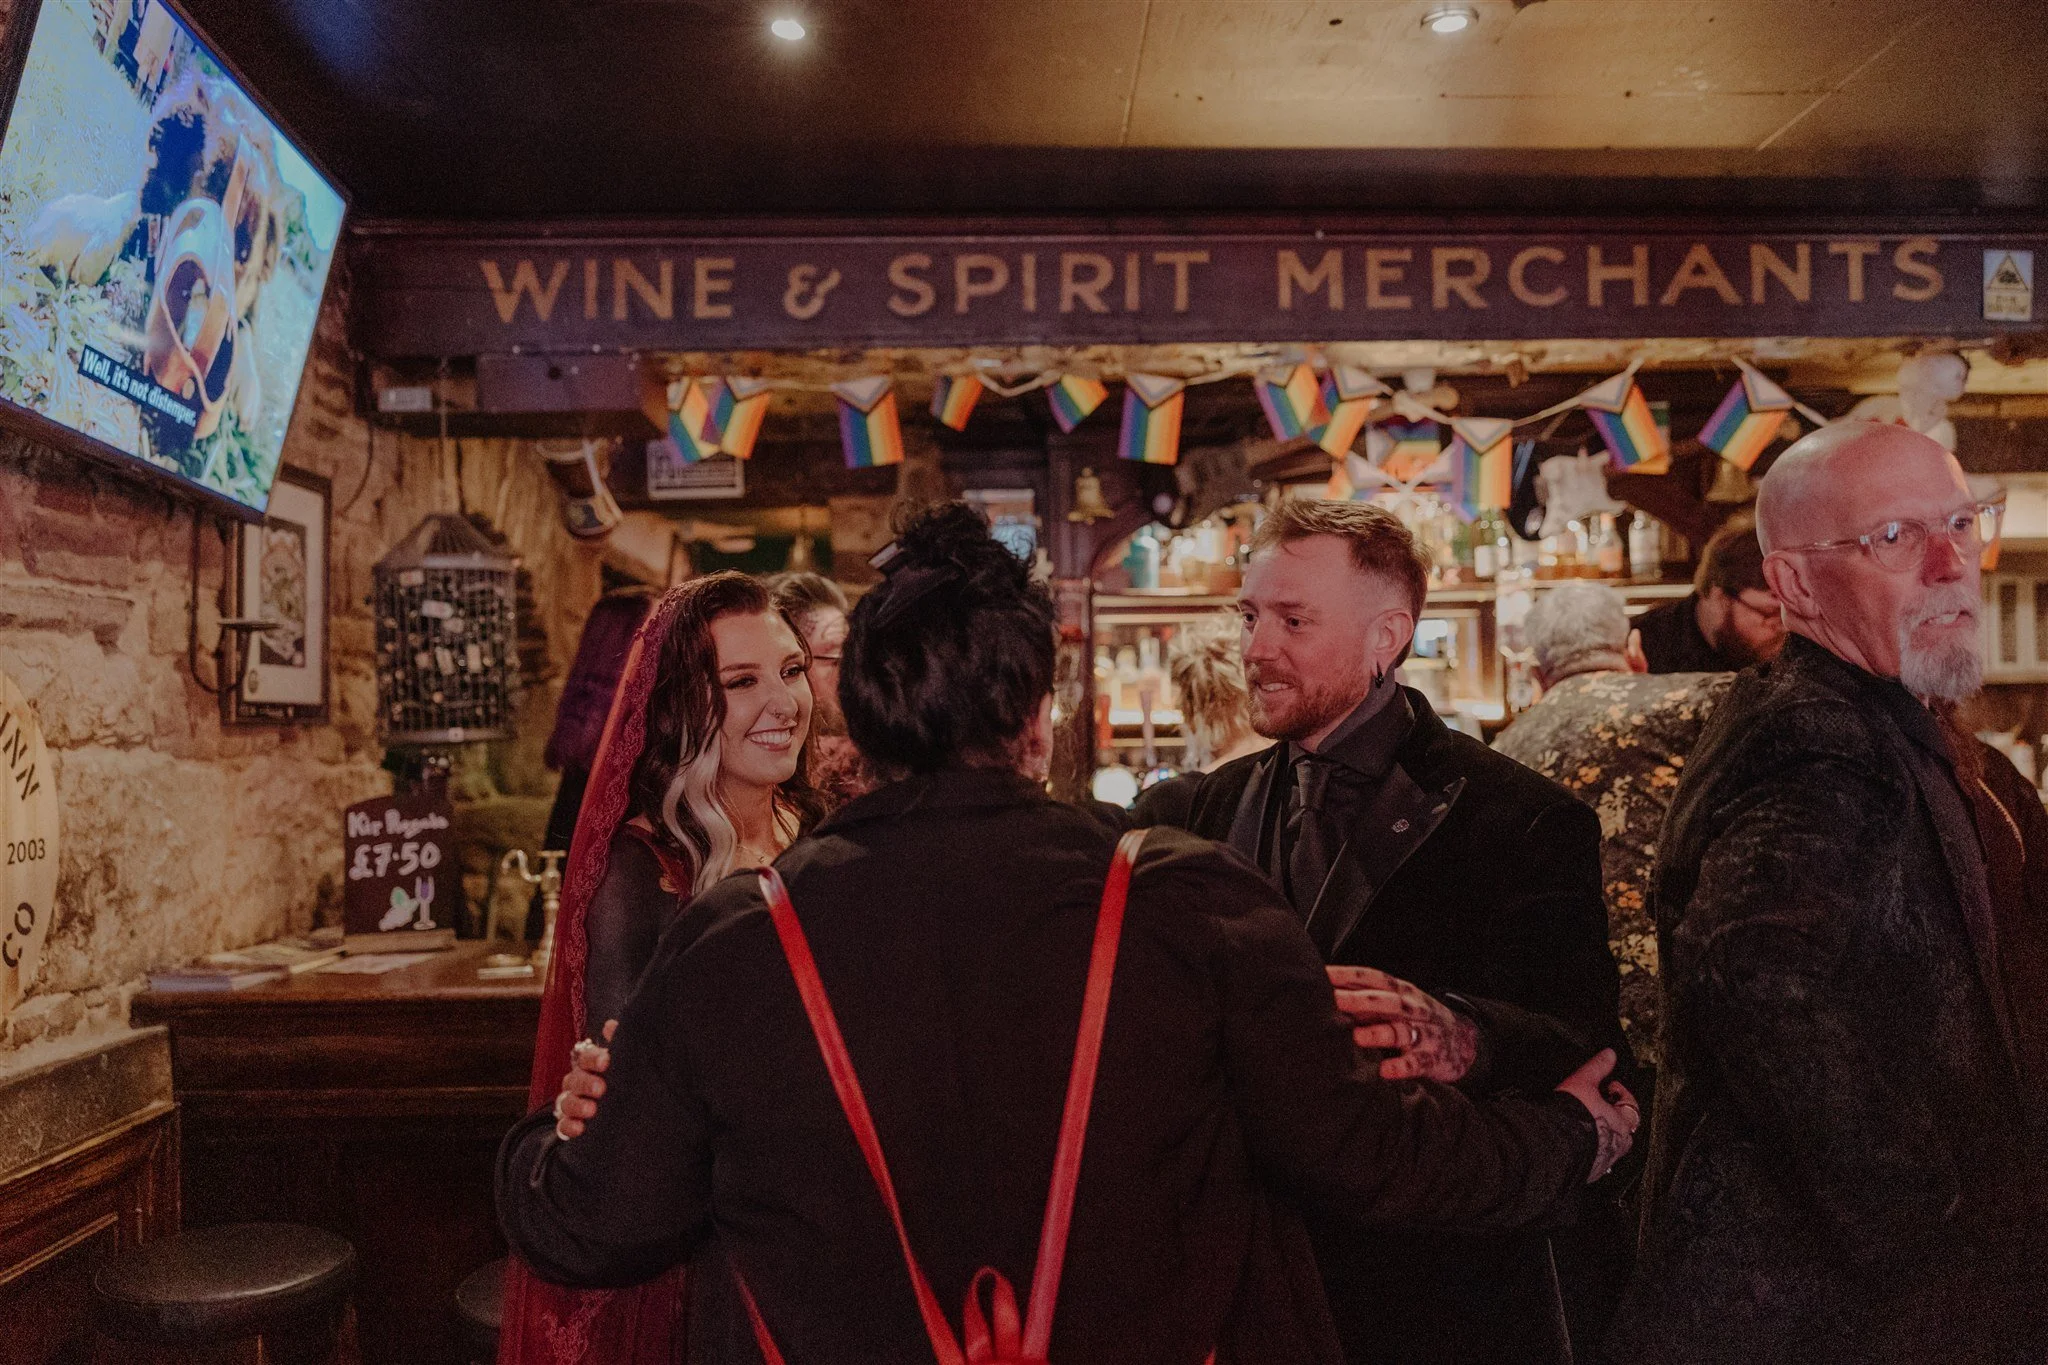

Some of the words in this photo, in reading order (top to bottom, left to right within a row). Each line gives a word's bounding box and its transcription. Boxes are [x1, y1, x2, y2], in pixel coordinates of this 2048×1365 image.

[480, 257, 736, 323] WINE
[783, 263, 842, 320] &
[886, 250, 1210, 317] SPIRIT
[1276, 236, 1945, 310] MERCHANTS
[82, 348, 111, 385] Well,
[128, 379, 150, 402] not
[6, 838, 46, 866] 2003
